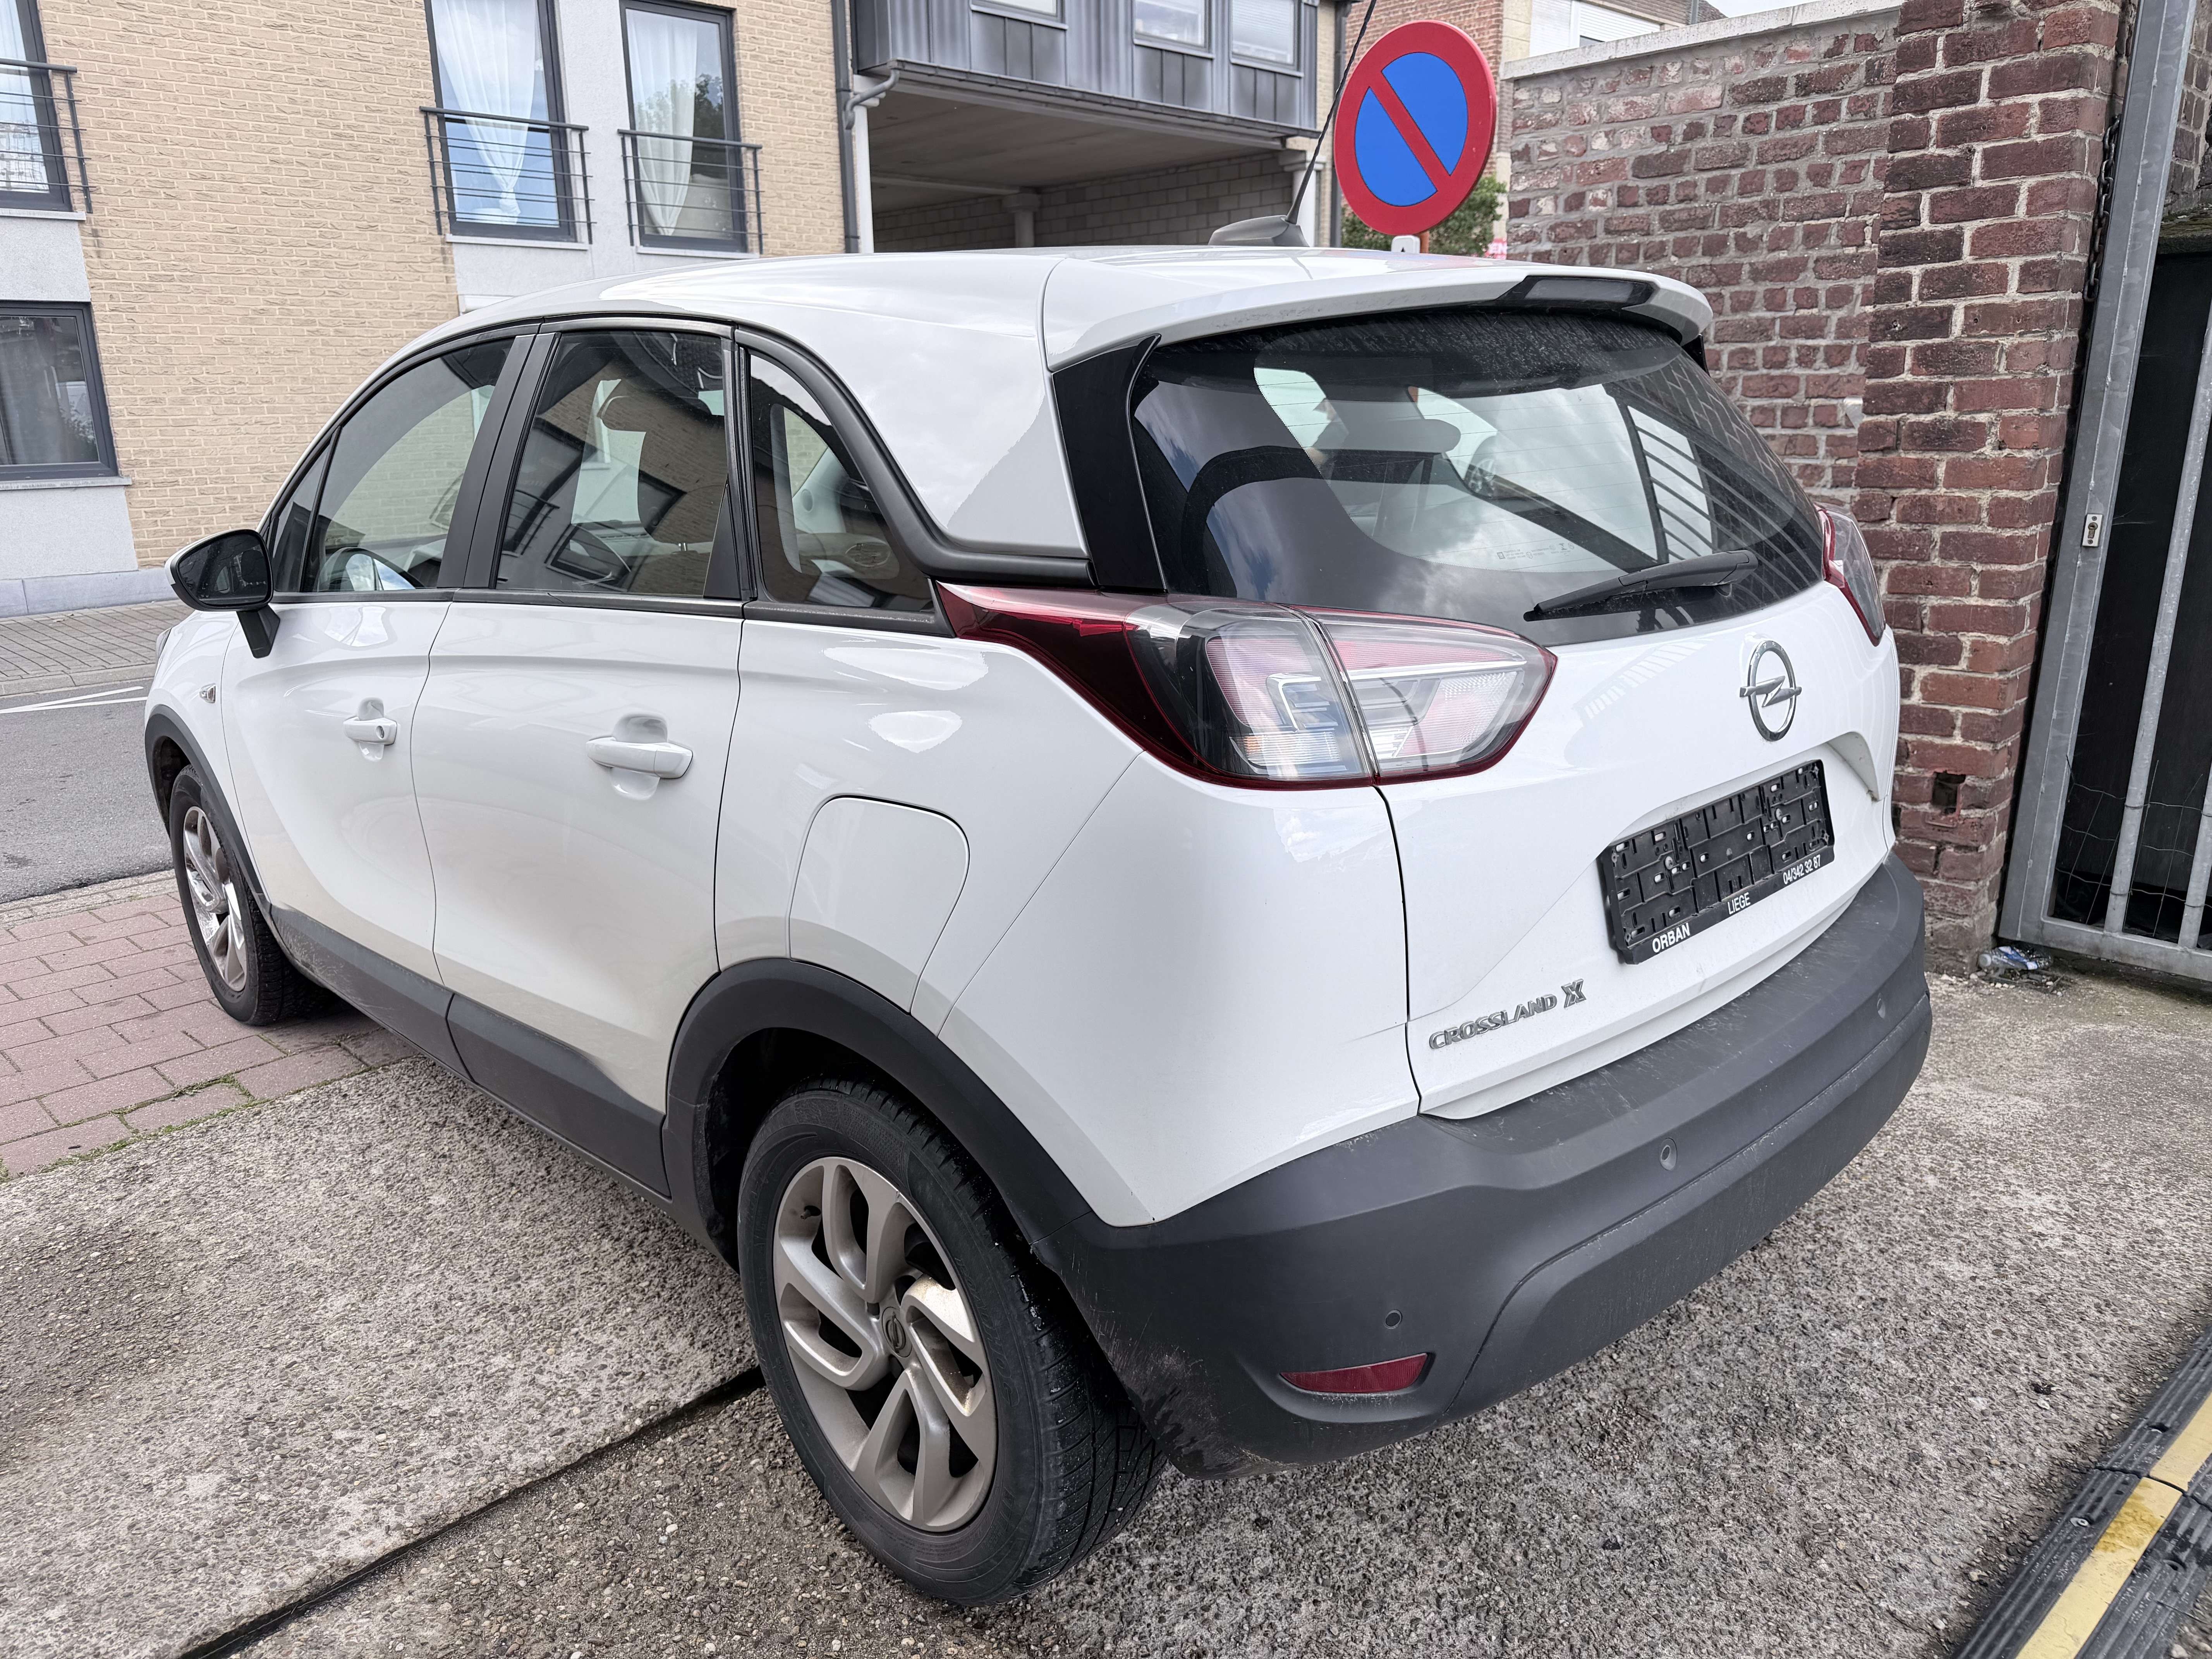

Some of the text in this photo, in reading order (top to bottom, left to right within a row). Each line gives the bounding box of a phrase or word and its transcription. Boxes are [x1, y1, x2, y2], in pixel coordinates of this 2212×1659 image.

[1783, 854, 1820, 884] 04/342 32 87
[1728, 892, 1751, 915] LIEGE
[1652, 922, 1690, 953] ORBAN
[1429, 978, 1587, 1049] CROSSLAND X
